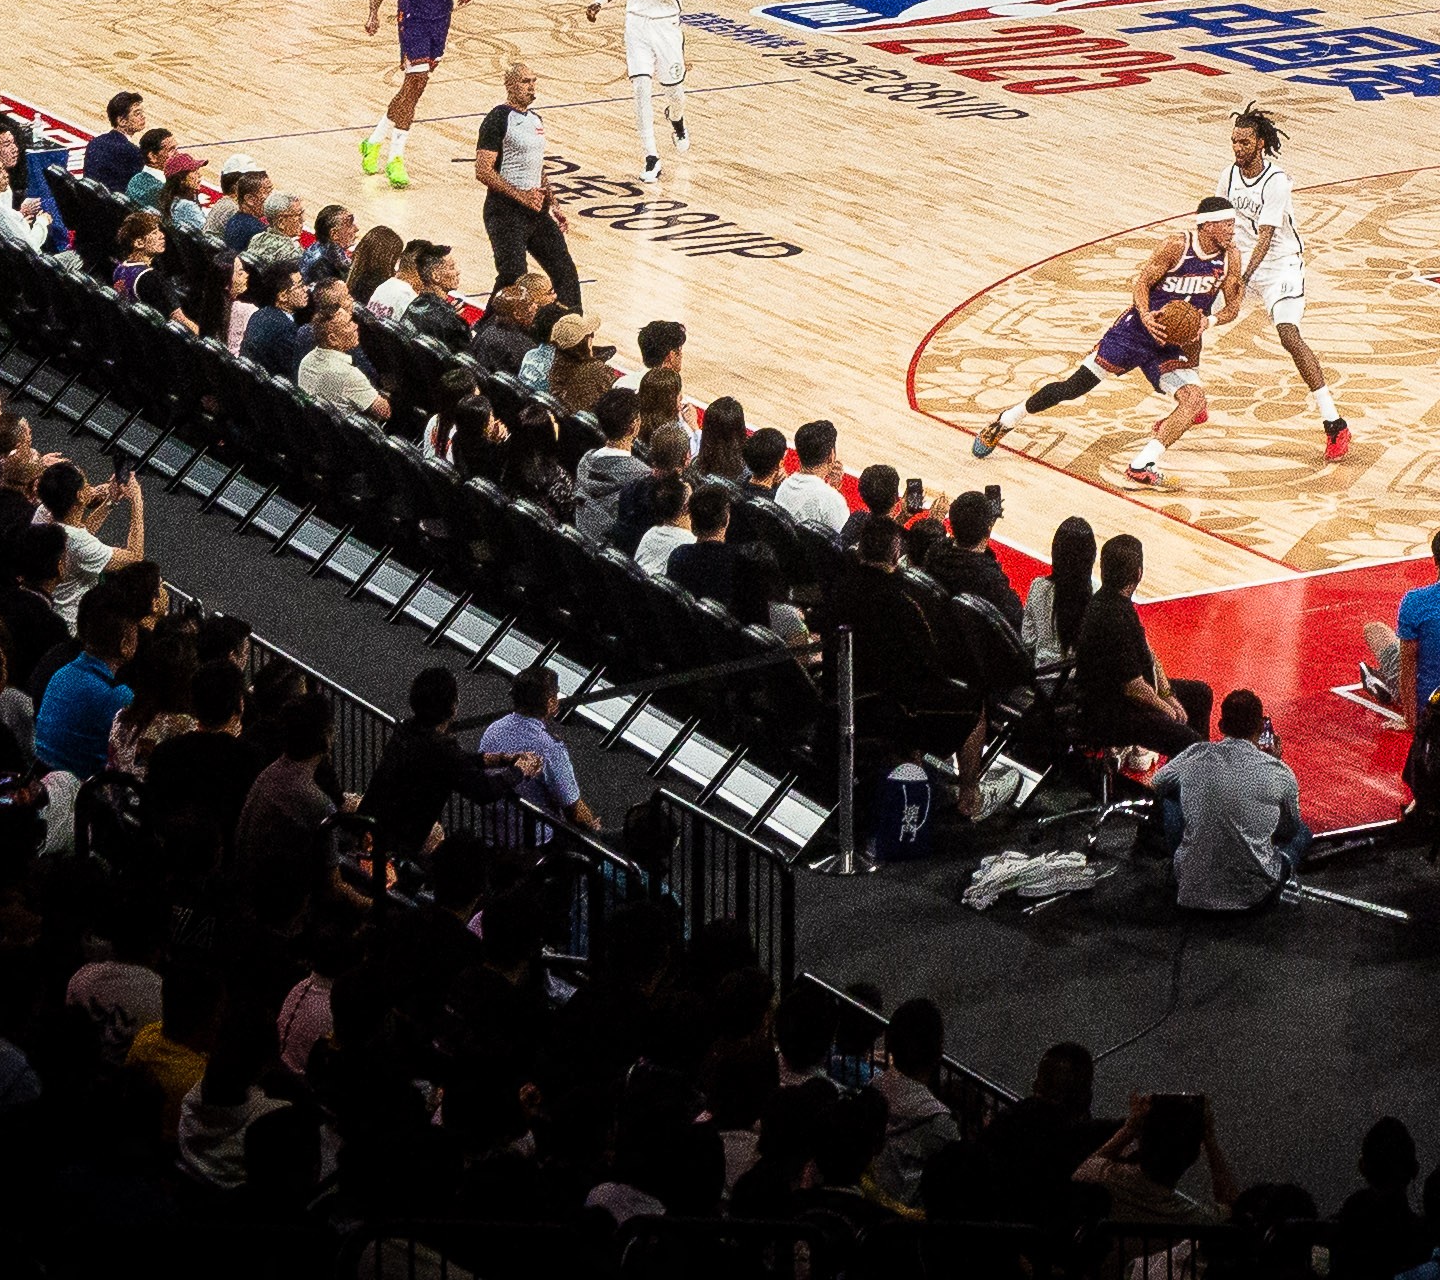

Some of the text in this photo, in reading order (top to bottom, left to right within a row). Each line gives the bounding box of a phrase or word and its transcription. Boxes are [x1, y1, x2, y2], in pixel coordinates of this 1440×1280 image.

[762, 49, 1030, 120] 淘宝88VIP
[869, 25, 1231, 97] 2025
[1162, 274, 1220, 296] SUNS
